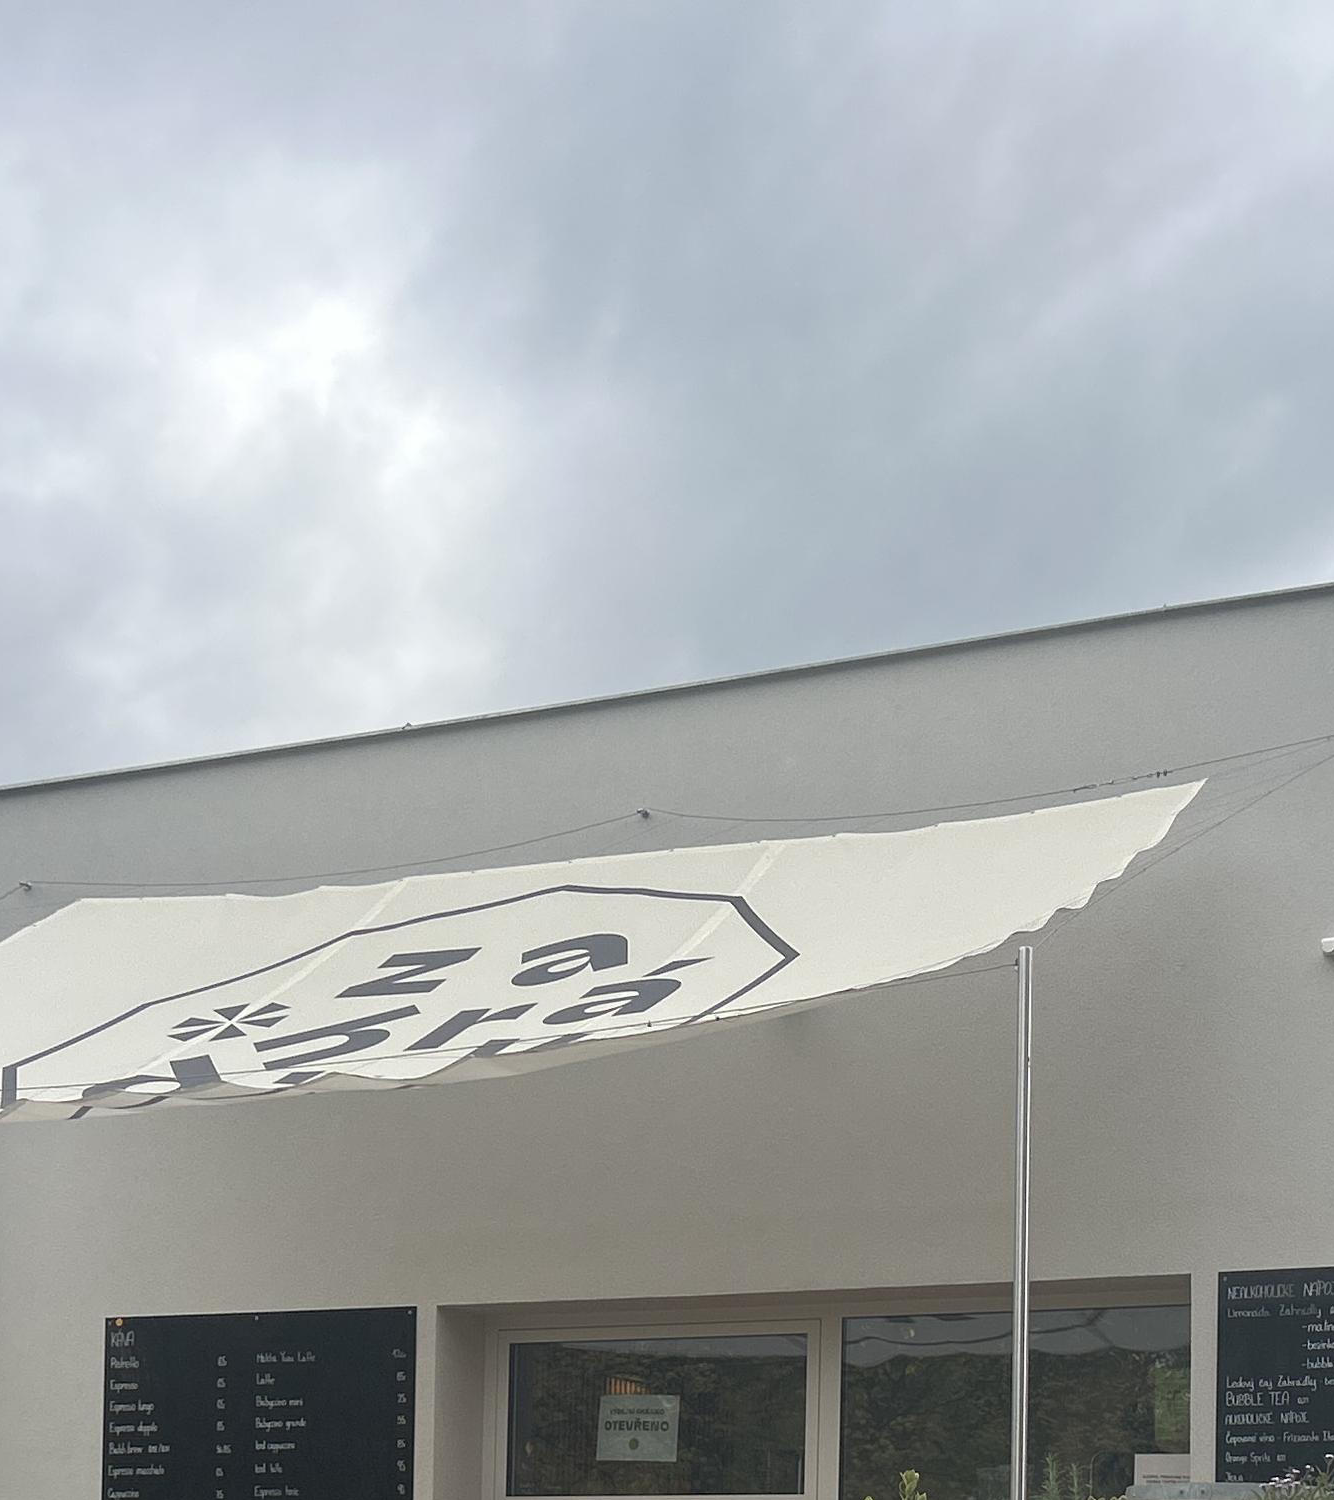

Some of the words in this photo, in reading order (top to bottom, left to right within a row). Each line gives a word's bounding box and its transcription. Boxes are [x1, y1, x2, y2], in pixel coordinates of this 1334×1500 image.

[1226, 1391, 1264, 1406] BUBBLE
[1269, 1391, 1290, 1406] TEA
[604, 1416, 669, 1432] OTEVŘENO
